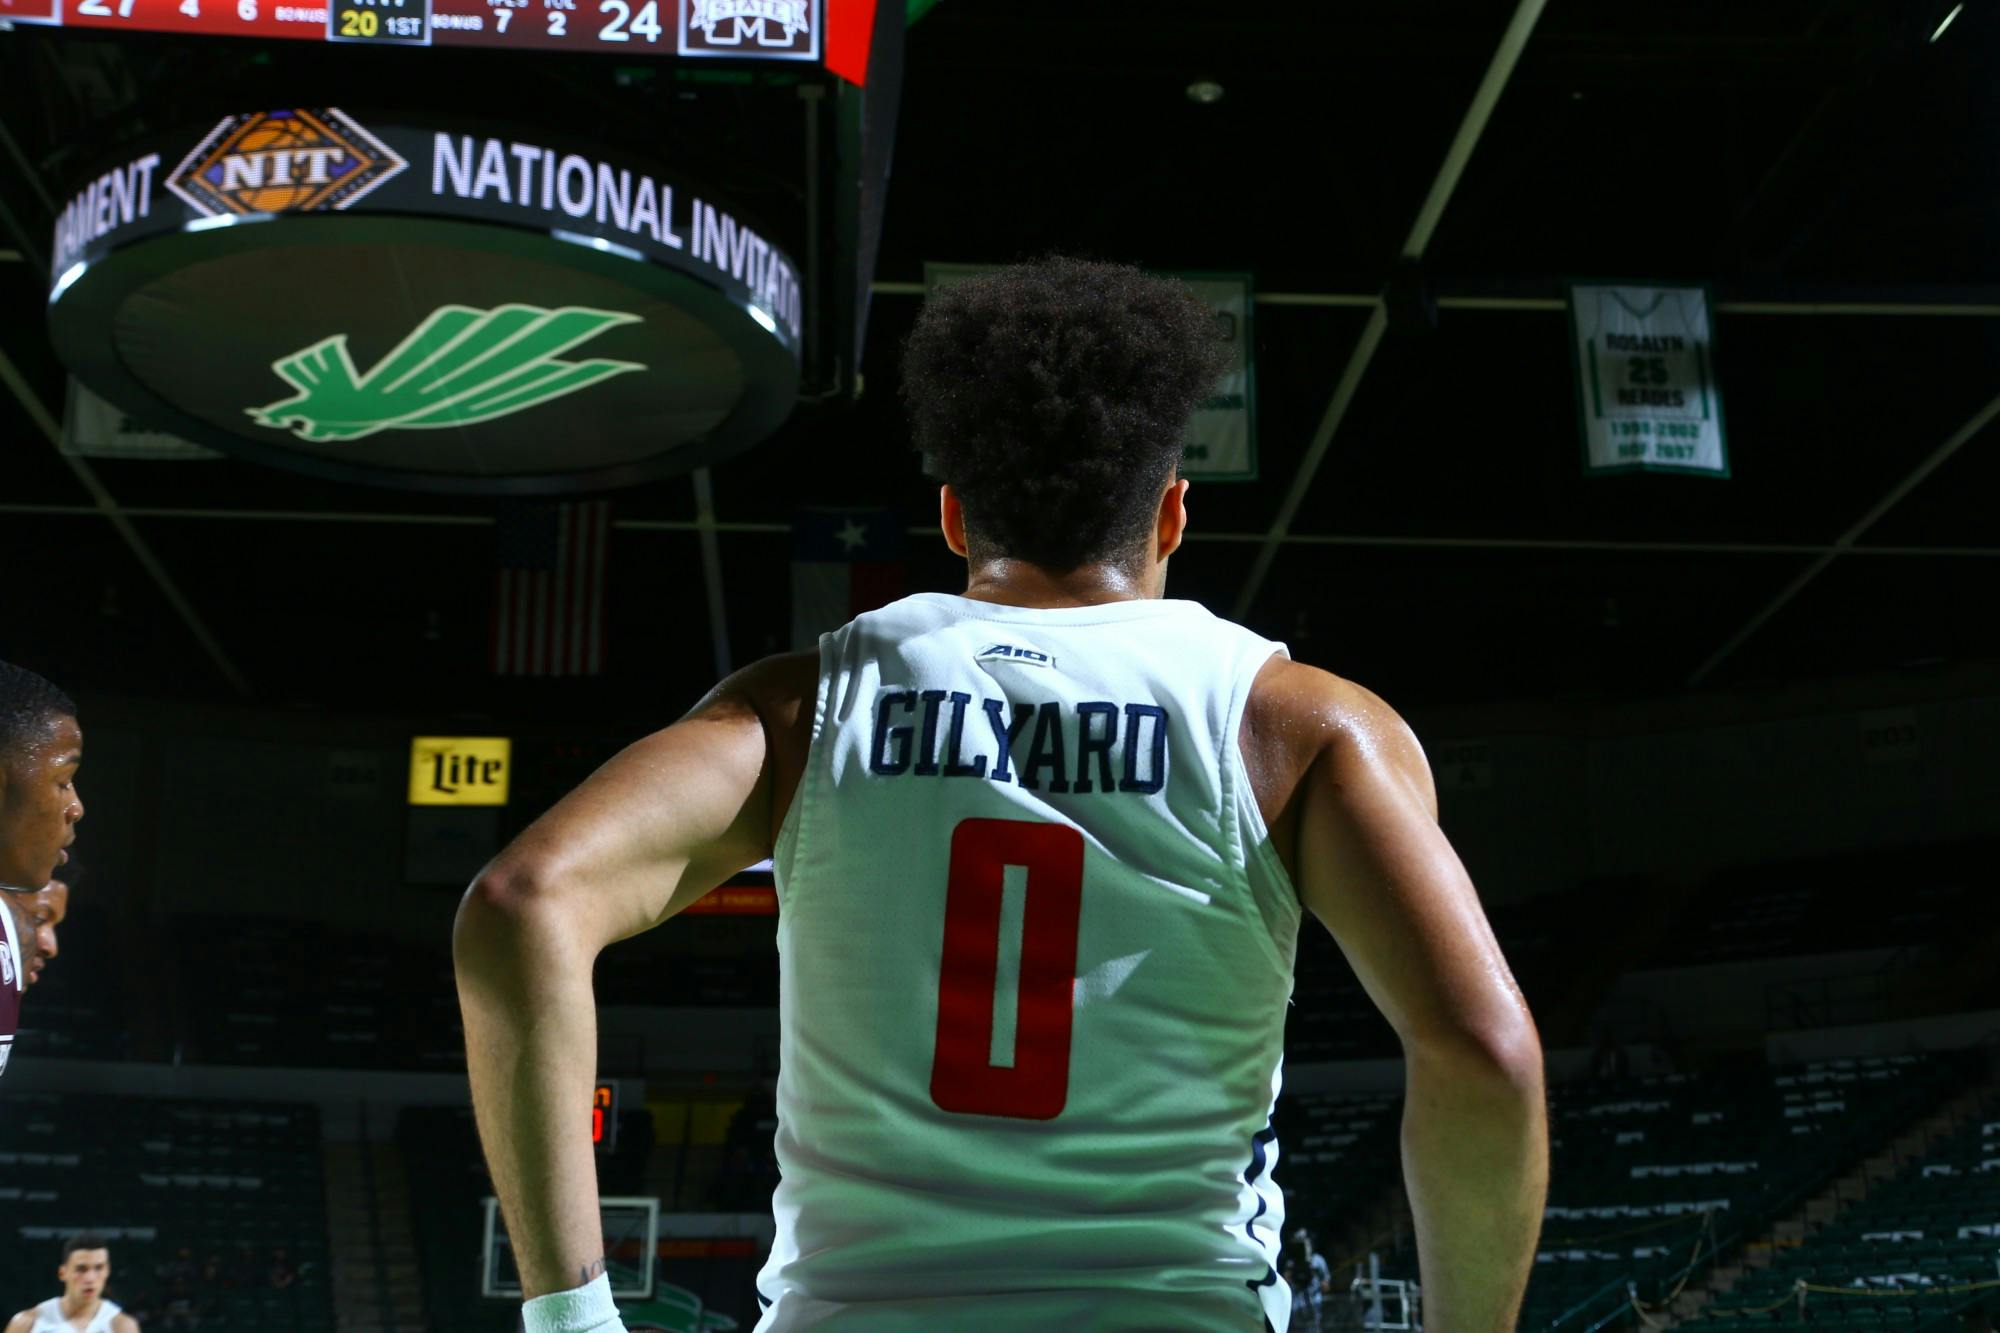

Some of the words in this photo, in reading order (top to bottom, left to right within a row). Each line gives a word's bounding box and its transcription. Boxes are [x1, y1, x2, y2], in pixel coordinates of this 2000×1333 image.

[236, 0, 258, 21] 6
[340, 10, 379, 37] 20
[385, 17, 422, 36] 1ST
[495, 8, 513, 33] 7
[547, 11, 567, 36] 2
[598, 0, 662, 42] 24
[221, 148, 346, 192] NIT
[432, 131, 682, 250] NATIONAL
[1629, 356, 1669, 385] 25
[869, 689, 1169, 794] GILYARD
[421, 747, 503, 793] Lite
[929, 817, 1085, 1121] 0
